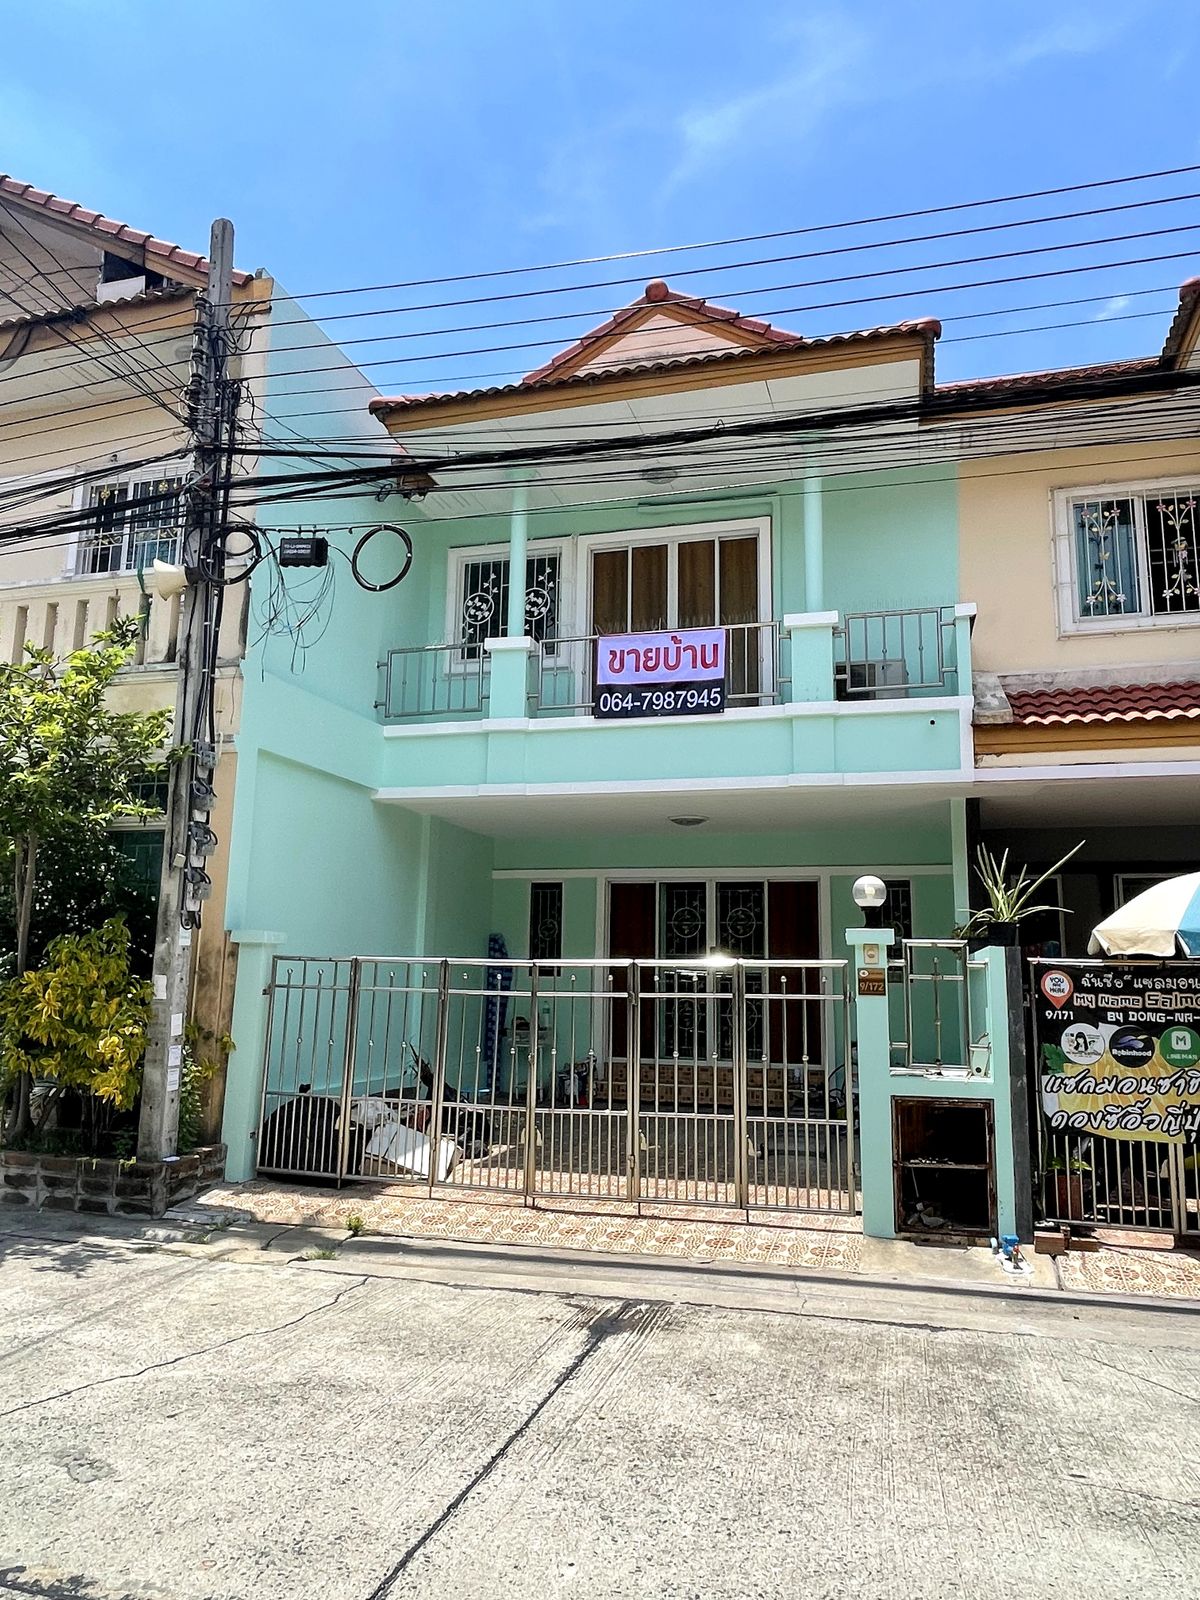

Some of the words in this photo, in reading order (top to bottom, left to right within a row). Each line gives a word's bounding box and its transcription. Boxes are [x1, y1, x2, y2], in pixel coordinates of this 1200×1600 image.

[608, 635, 719, 674] ขายบ้าน
[599, 687, 721, 712] 064-7987945
[859, 981, 885, 991] 9/172
[1045, 1010, 1074, 1020] 9/171
[1112, 1049, 1152, 1057] Robinhood
